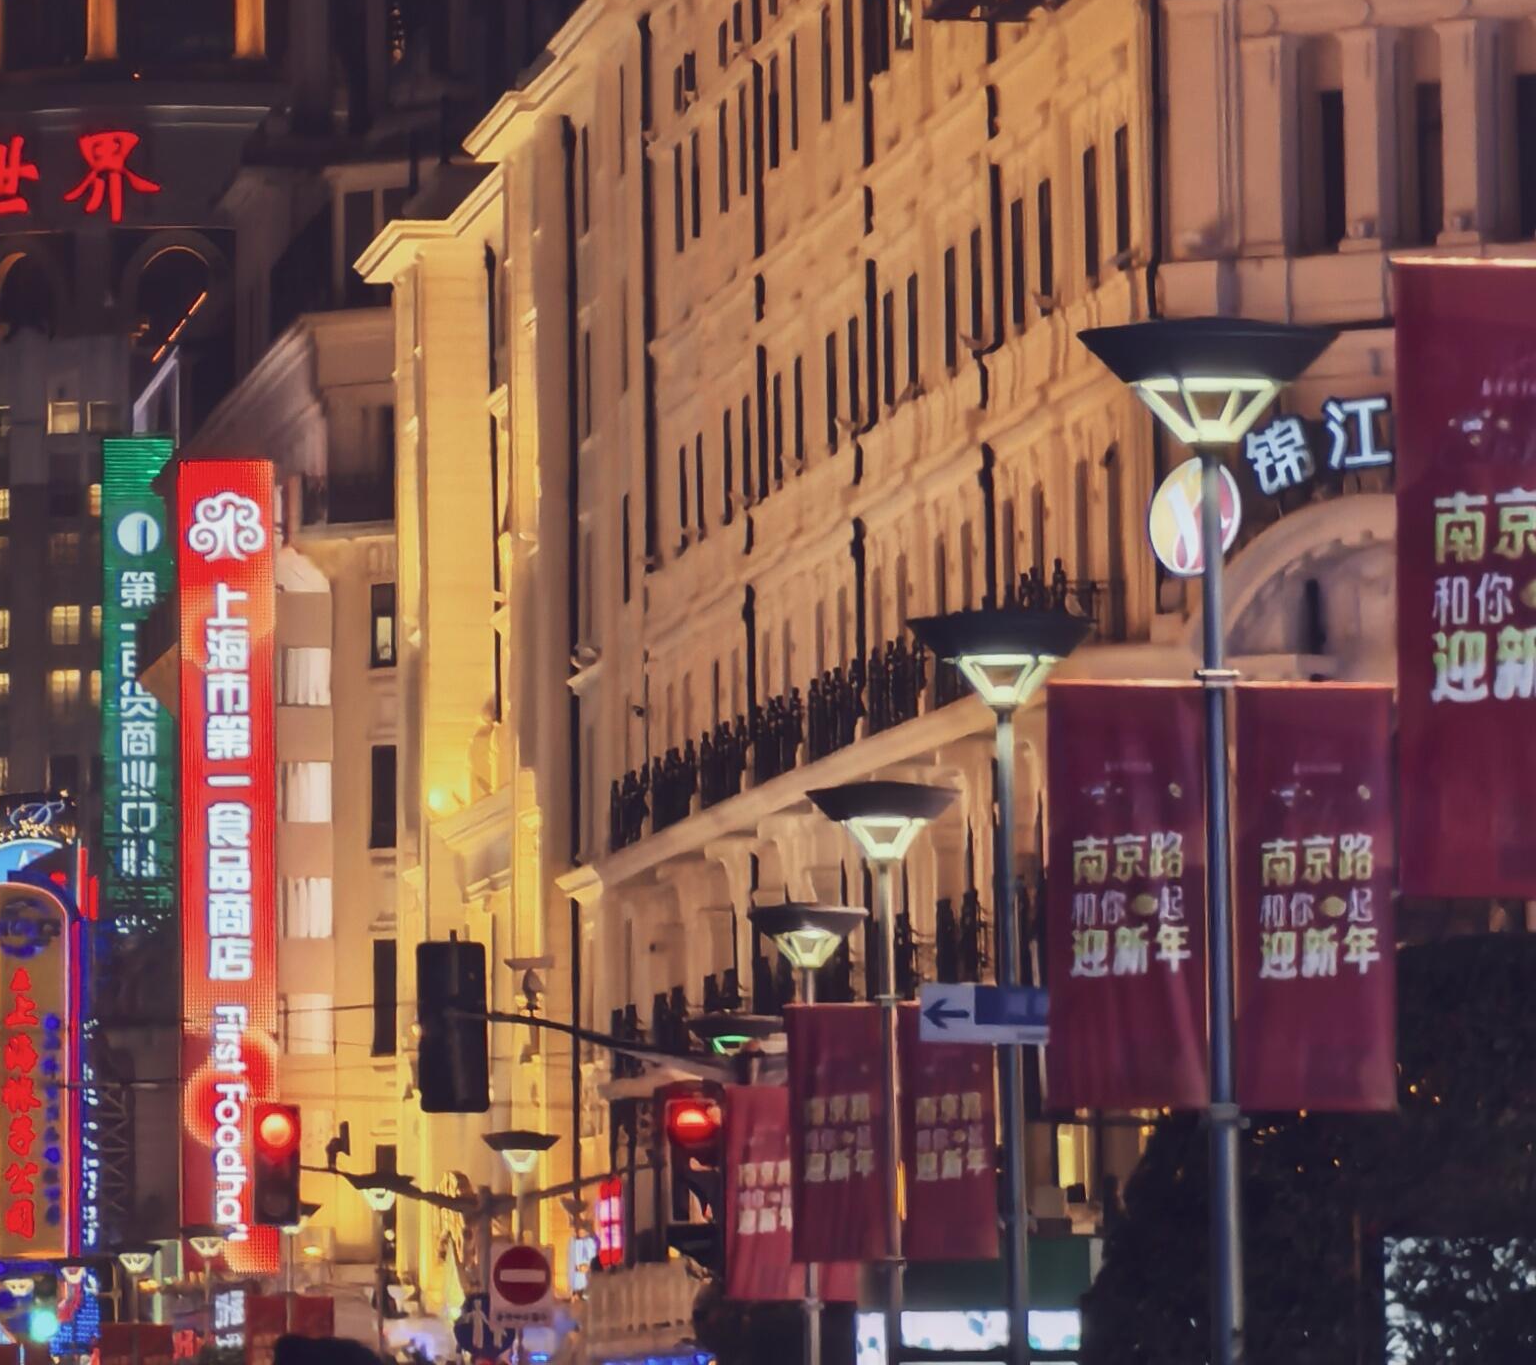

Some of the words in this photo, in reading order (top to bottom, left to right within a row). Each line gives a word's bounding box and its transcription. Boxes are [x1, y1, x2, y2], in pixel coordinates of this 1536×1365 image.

[1246, 398, 1392, 495] 锦江
[206, 581, 252, 981] 上海市第一食品商店
[1073, 831, 1183, 885] 南京路
[1260, 832, 1373, 886] 南京路
[1070, 924, 1191, 977] 迎新年
[1259, 925, 1381, 980] 迎新年
[214, 1005, 248, 1074] First
